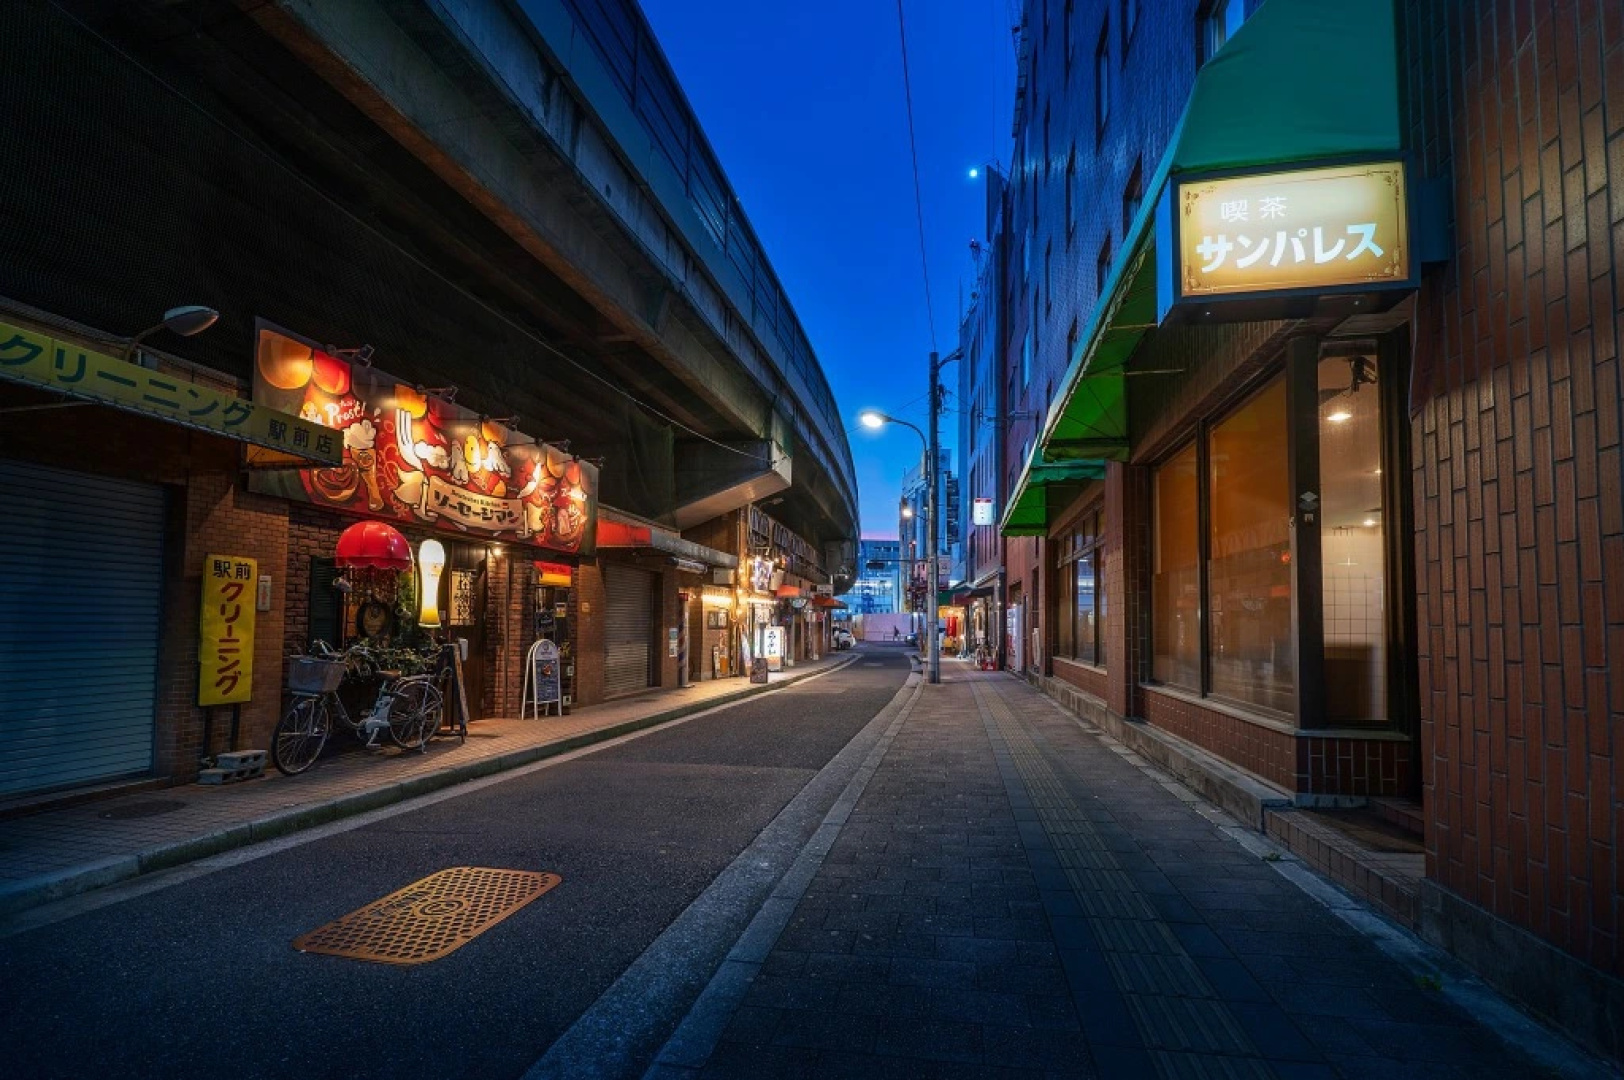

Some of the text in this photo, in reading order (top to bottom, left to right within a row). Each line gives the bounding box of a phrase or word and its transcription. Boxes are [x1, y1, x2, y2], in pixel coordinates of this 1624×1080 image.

[1220, 196, 1287, 222] 喫茶
[1196, 223, 1384, 273] サンパレス
[0, 334, 334, 454] クリーニング 駅前店
[434, 489, 519, 523] ソーセージマン
[213, 559, 250, 580] 駅前
[215, 581, 242, 696] クリーニング
